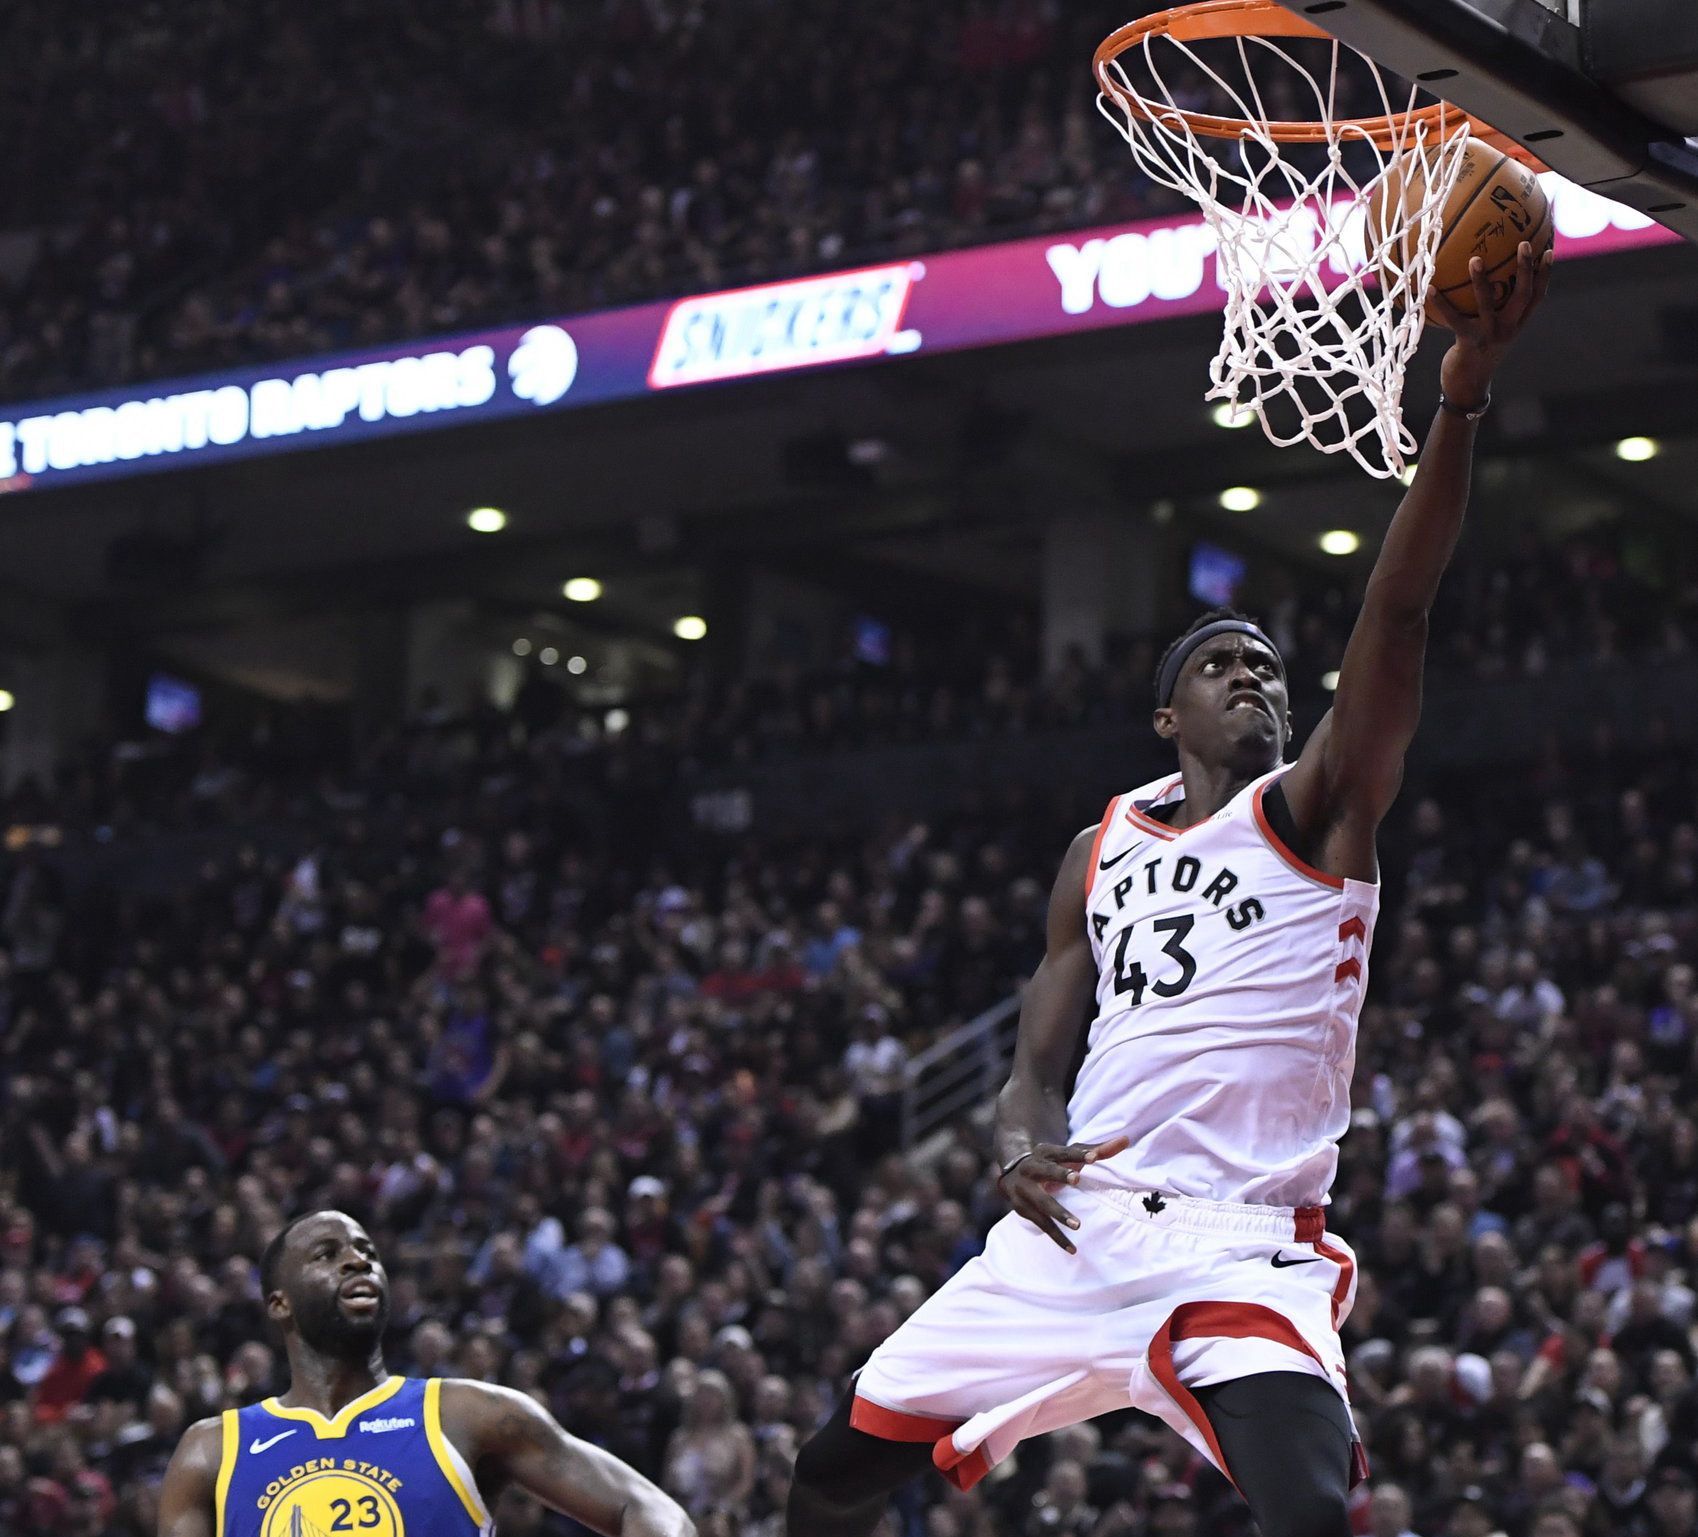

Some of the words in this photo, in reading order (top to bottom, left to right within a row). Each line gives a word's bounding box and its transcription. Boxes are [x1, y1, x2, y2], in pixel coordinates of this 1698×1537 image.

[670, 279, 895, 371] SNICKERS
[17, 386, 248, 472] TORONTO
[251, 346, 495, 437] RAPTORS
[1113, 913, 1198, 1007] 43
[359, 1417, 416, 1434] Rakuten
[256, 1457, 336, 1510] GOLDEN
[343, 1458, 403, 1493] STATE
[329, 1495, 382, 1533] 23
